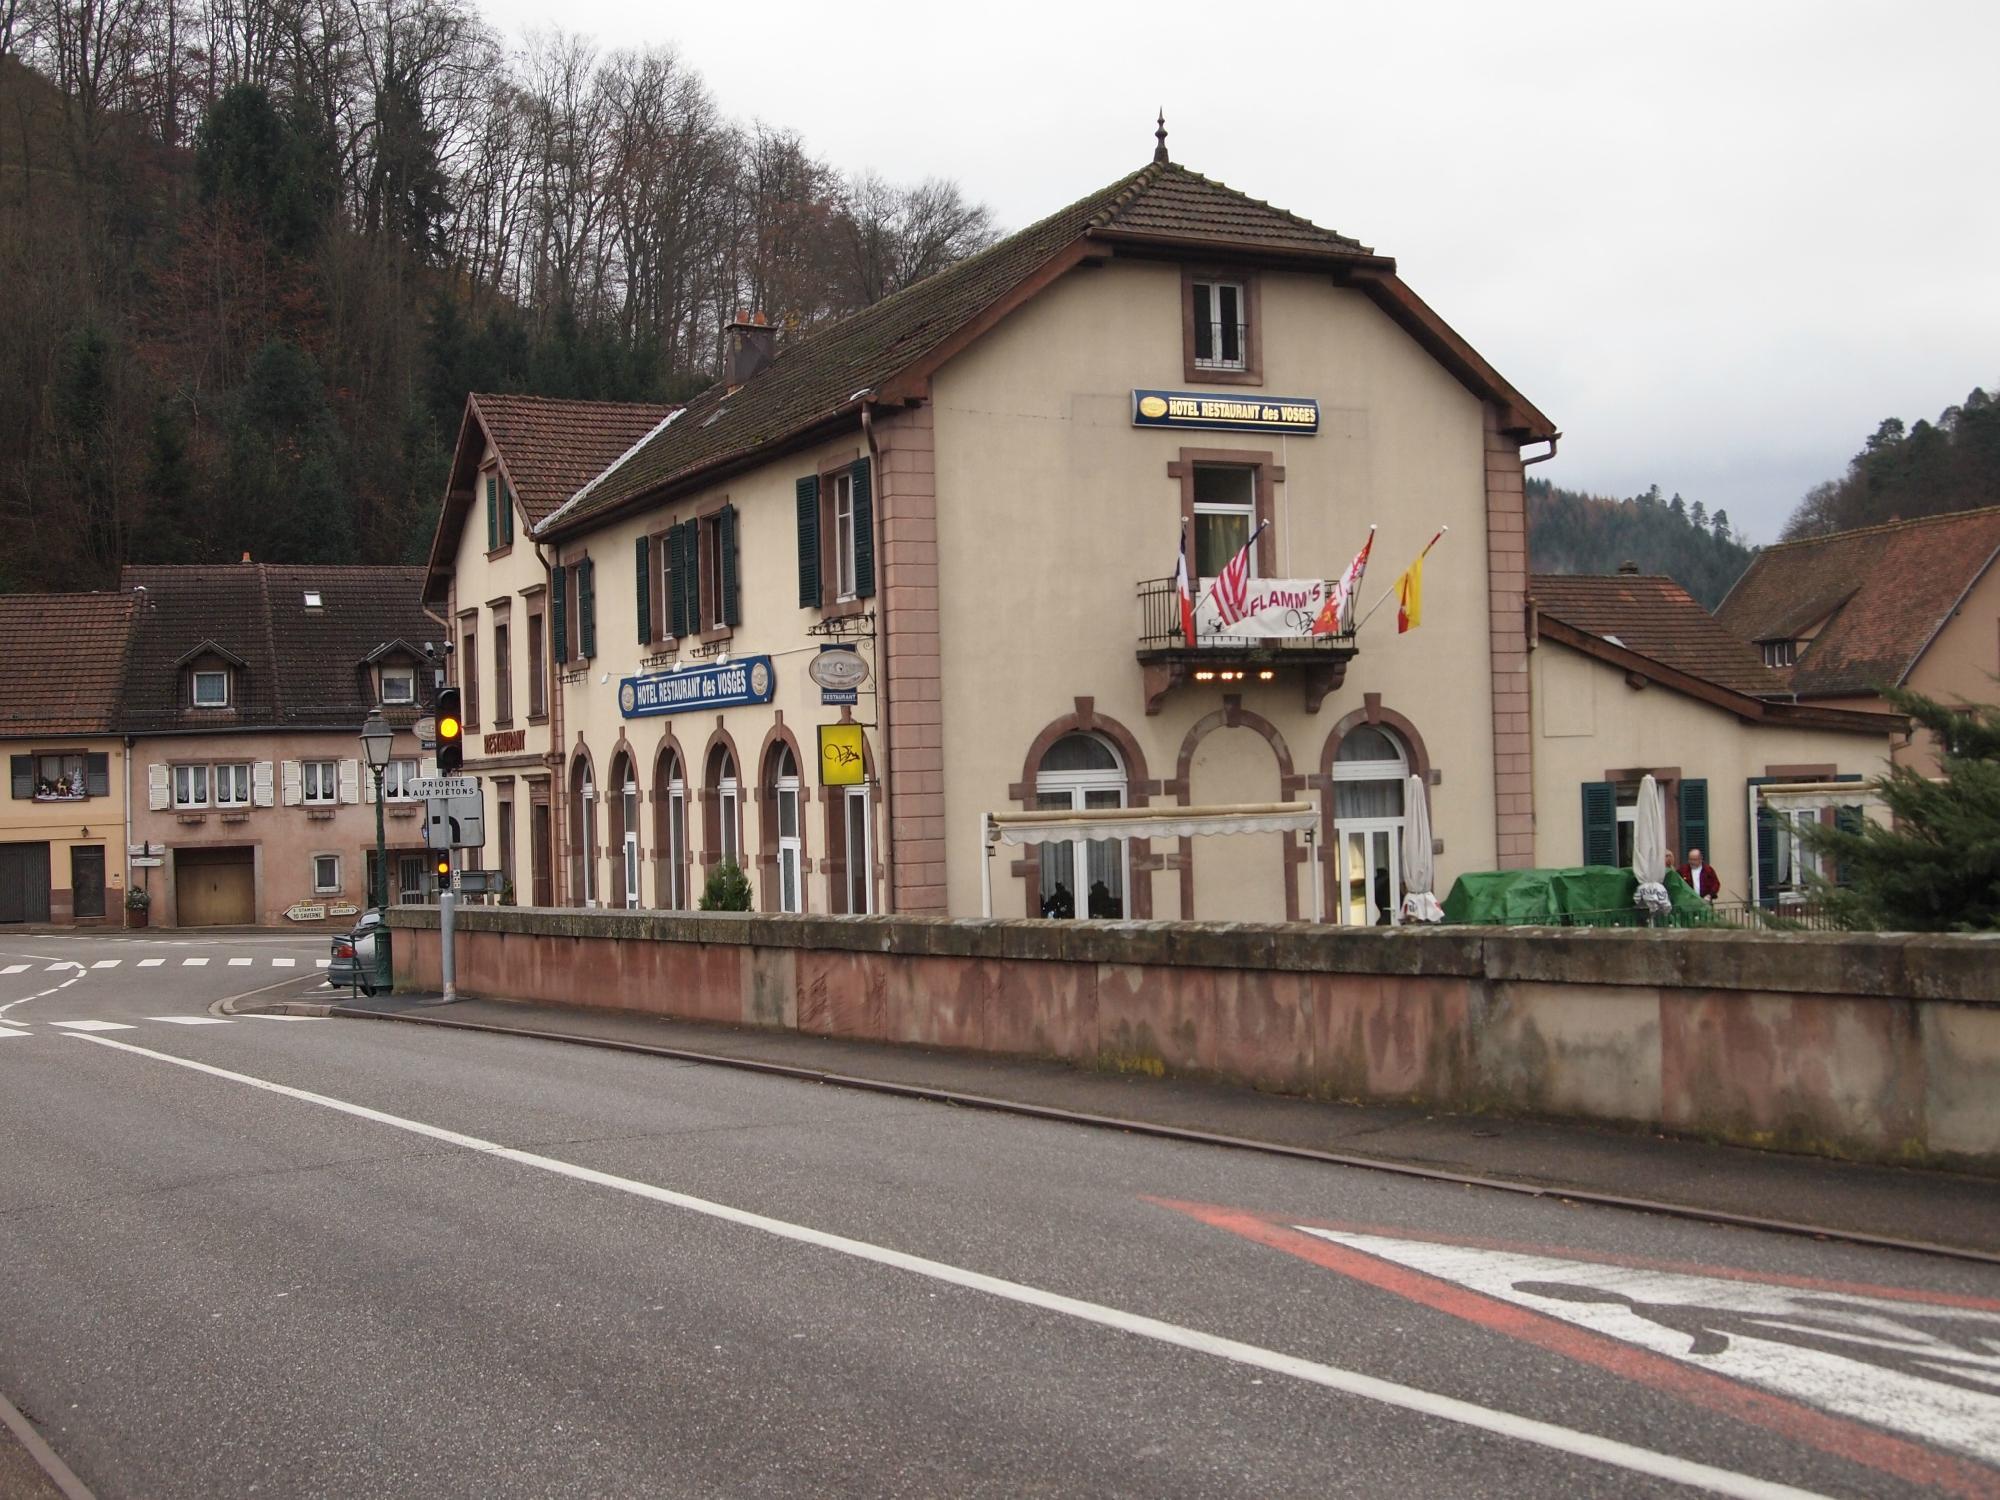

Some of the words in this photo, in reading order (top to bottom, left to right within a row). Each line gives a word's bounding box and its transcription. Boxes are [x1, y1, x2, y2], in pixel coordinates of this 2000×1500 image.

[1169, 400, 1199, 416] HOTEL
[1201, 402, 1260, 420] RESTAURANT
[1262, 406, 1279, 420] des
[1281, 407, 1316, 423] VOSGES
[1250, 583, 1321, 617] FLAMM'S
[637, 684, 657, 705] HOTEL
[659, 677, 701, 703] RESTAURANT
[702, 676, 716, 697] des
[717, 670, 747, 695] VOSGES
[484, 730, 526, 754] RESTAURANT
[413, 789, 431, 797] AUX
[435, 788, 474, 796] PIÉTONS
[422, 779, 465, 788] PRIORITÉ
